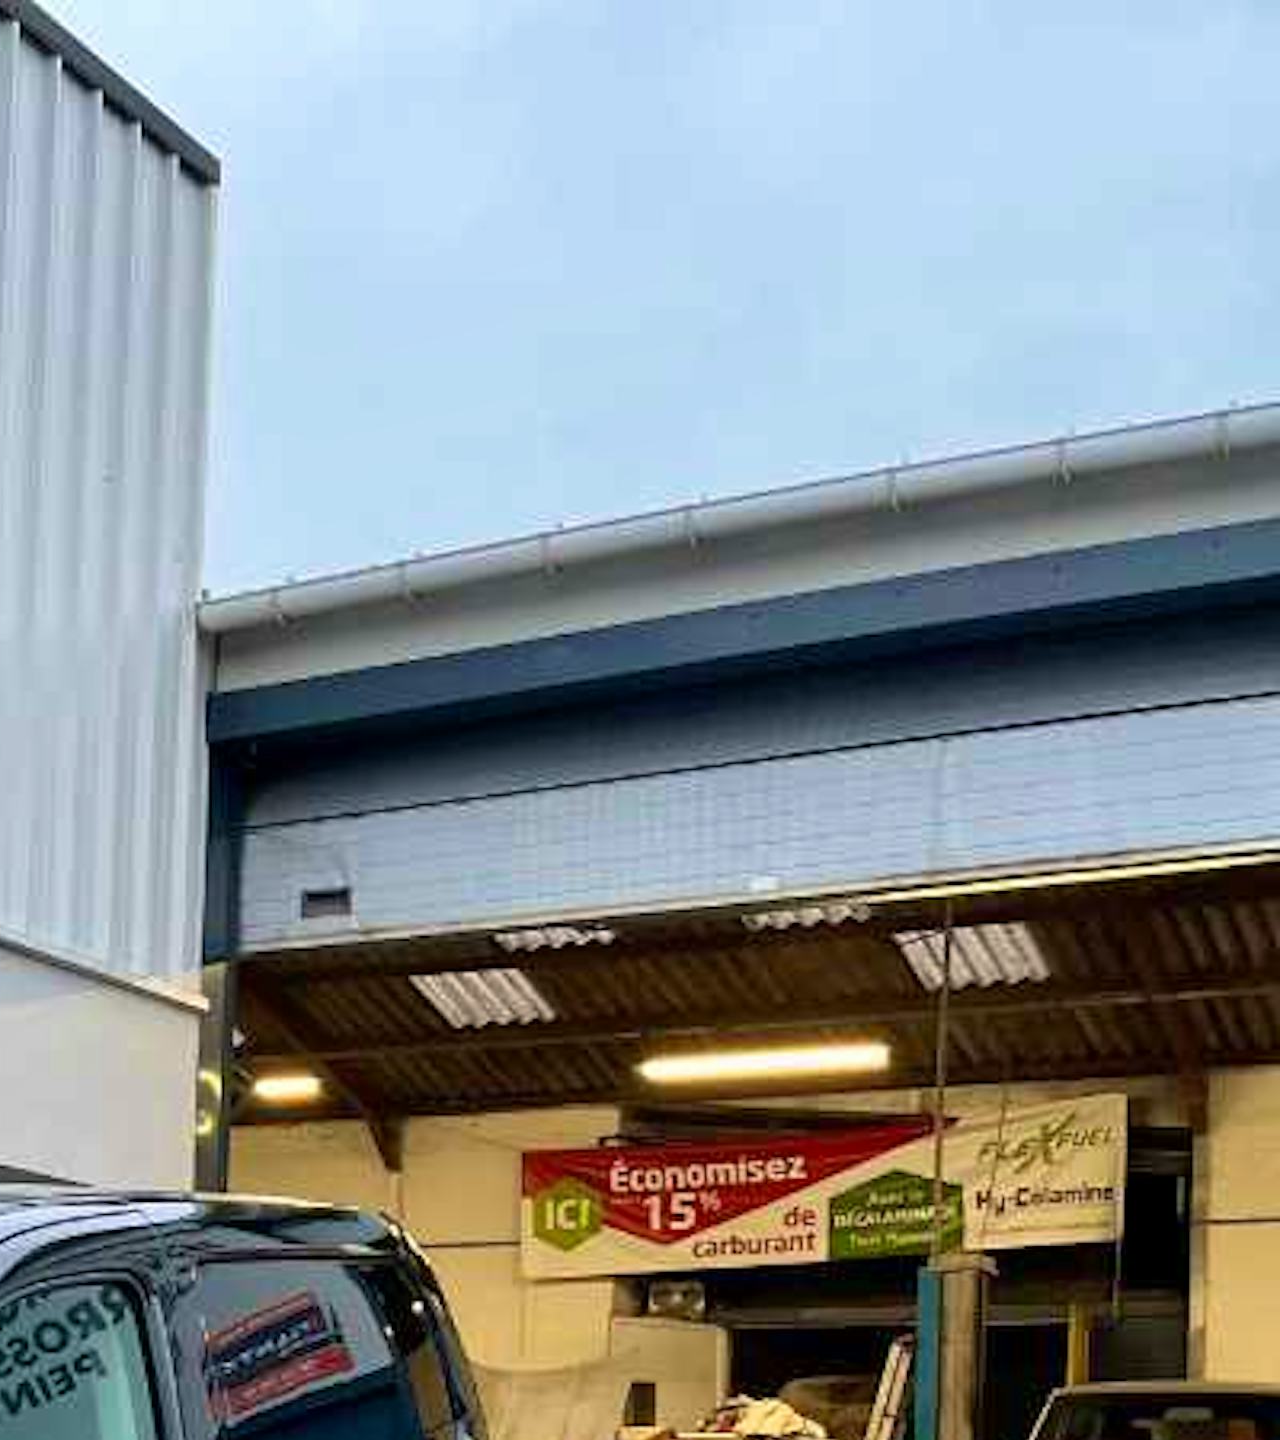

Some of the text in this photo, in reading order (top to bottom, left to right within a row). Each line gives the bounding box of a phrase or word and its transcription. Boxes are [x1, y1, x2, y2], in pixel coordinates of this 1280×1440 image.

[609, 1154, 808, 1193] Économisez
[545, 1198, 590, 1230] ICI
[784, 1206, 817, 1226] de
[693, 1231, 817, 1259] carburant
